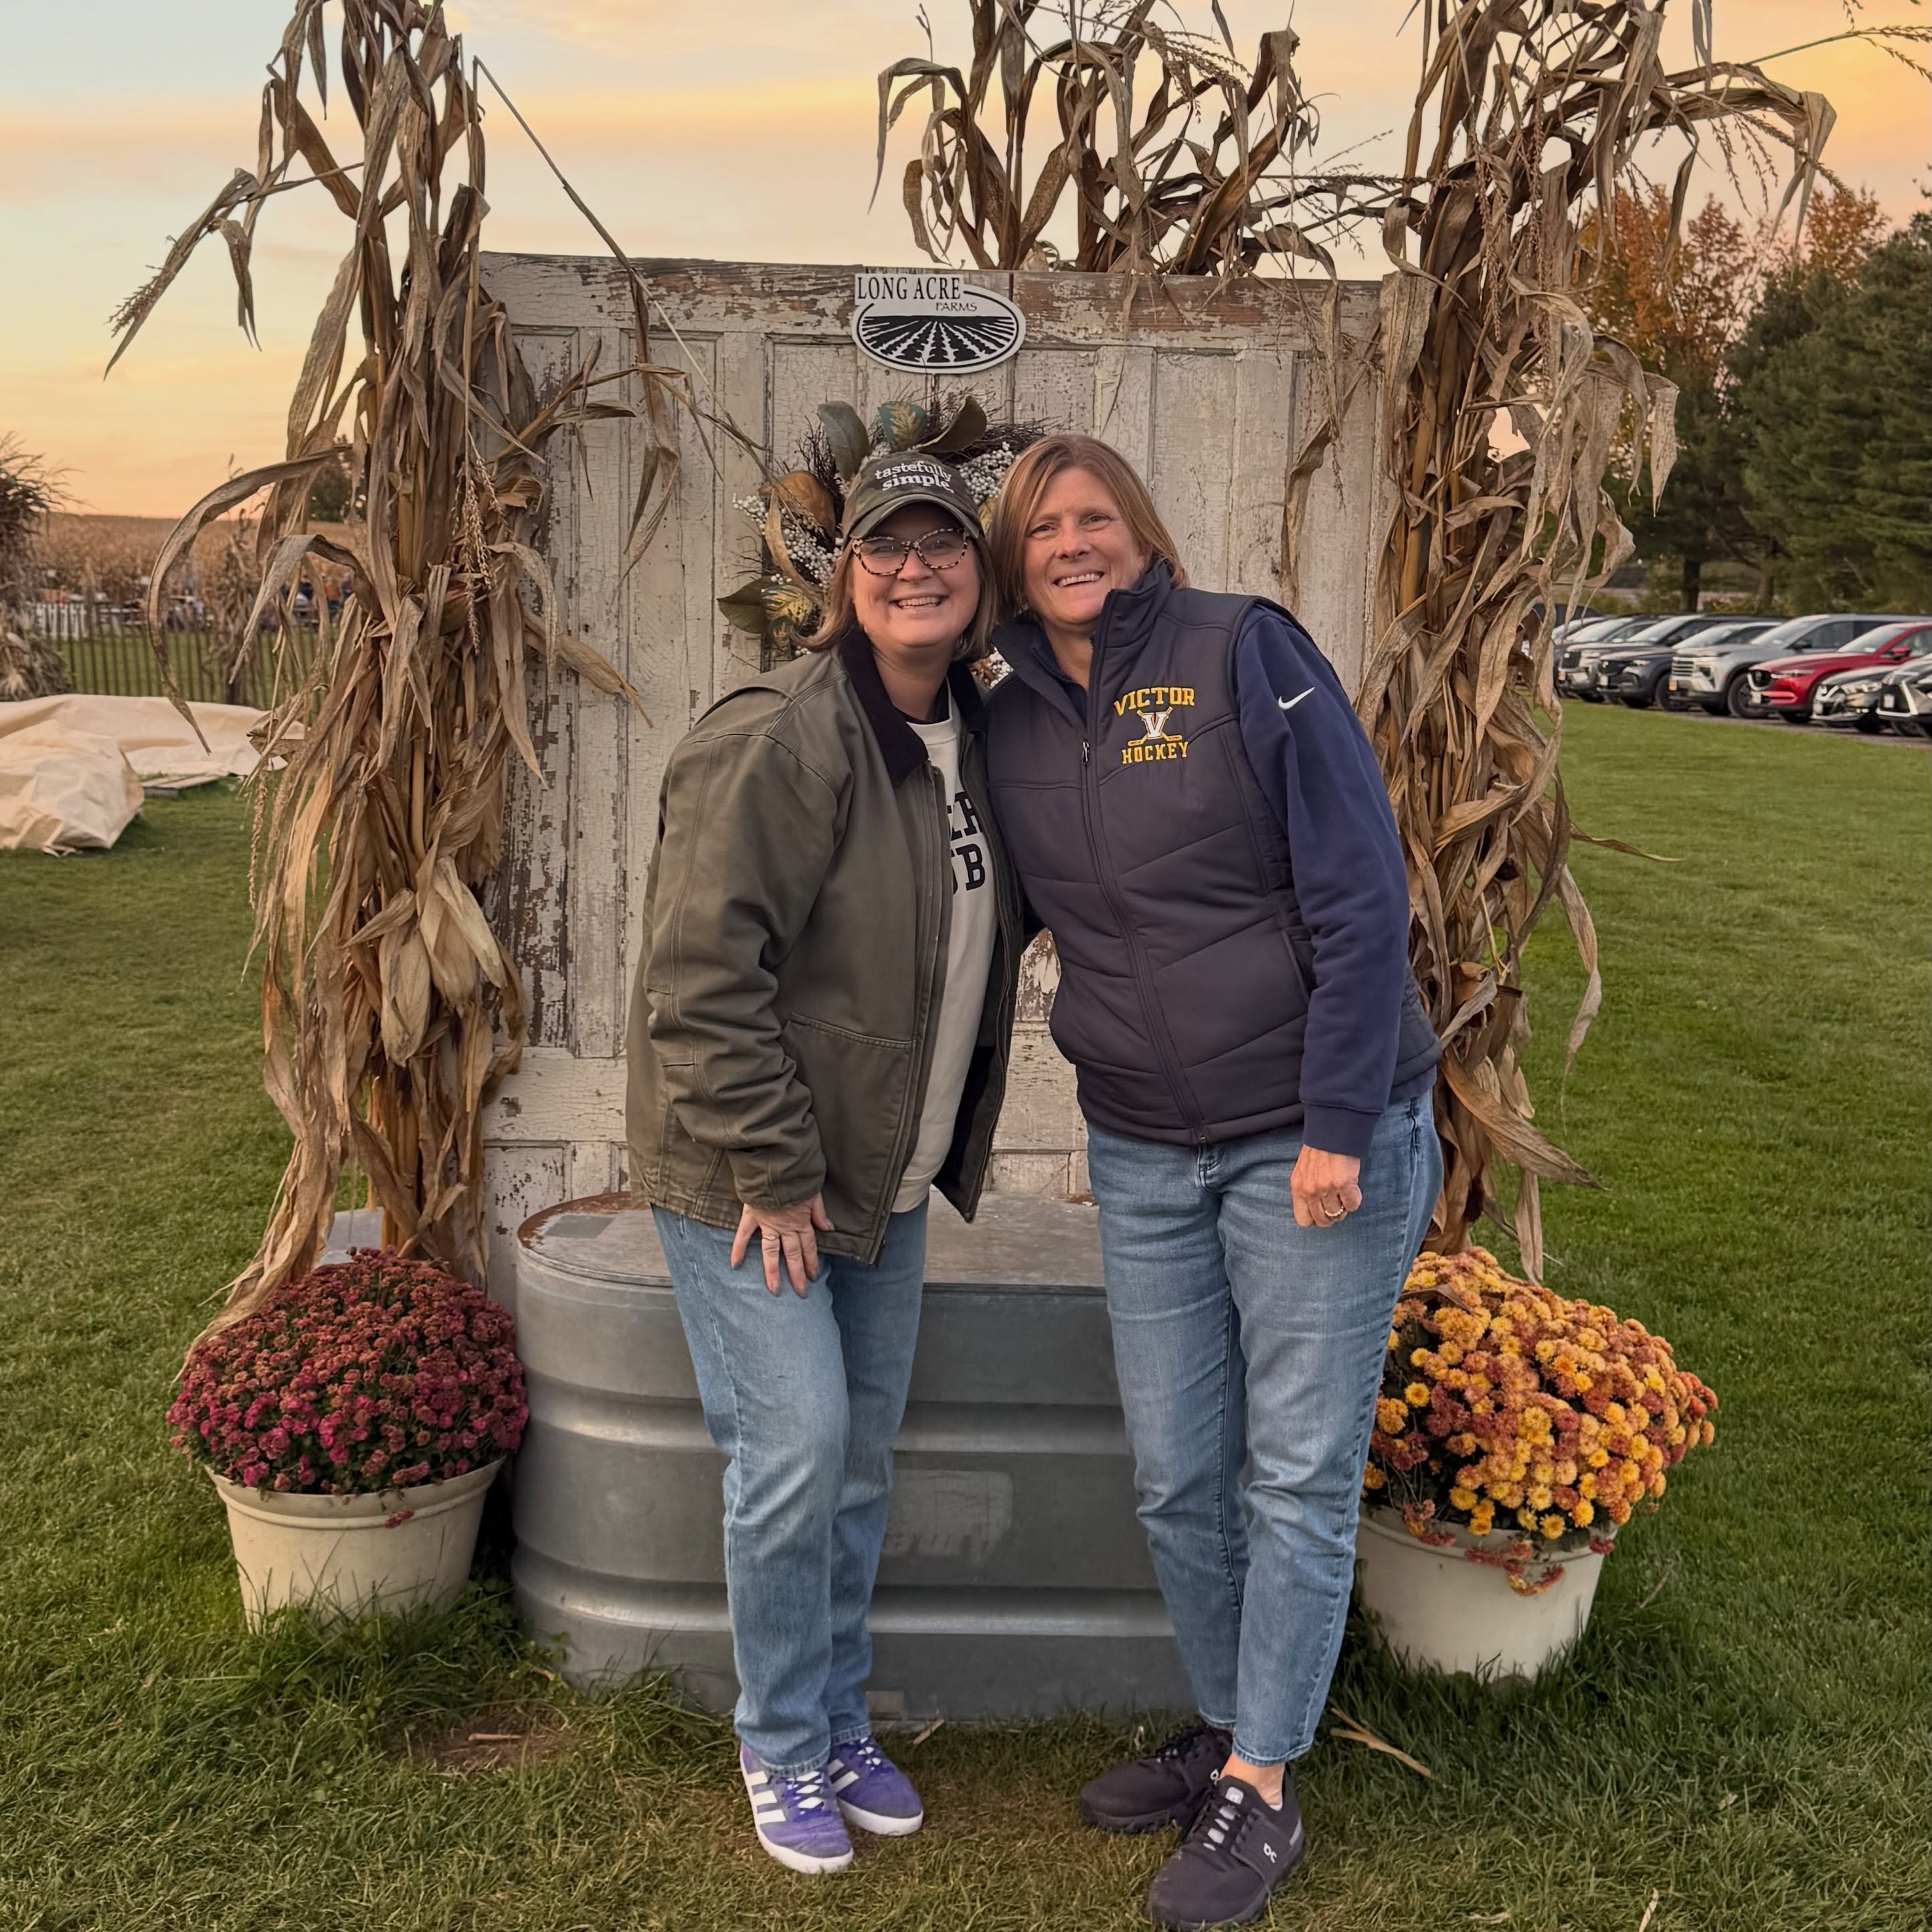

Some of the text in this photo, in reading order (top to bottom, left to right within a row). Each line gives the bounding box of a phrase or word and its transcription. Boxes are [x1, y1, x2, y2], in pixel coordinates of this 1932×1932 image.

[857, 277, 961, 299] LONG ACRE
[875, 460, 952, 482] tastefully
[882, 474, 954, 495] simple
[1114, 687, 1195, 716] VICTOR
[1121, 741, 1189, 764] HOCKEY
